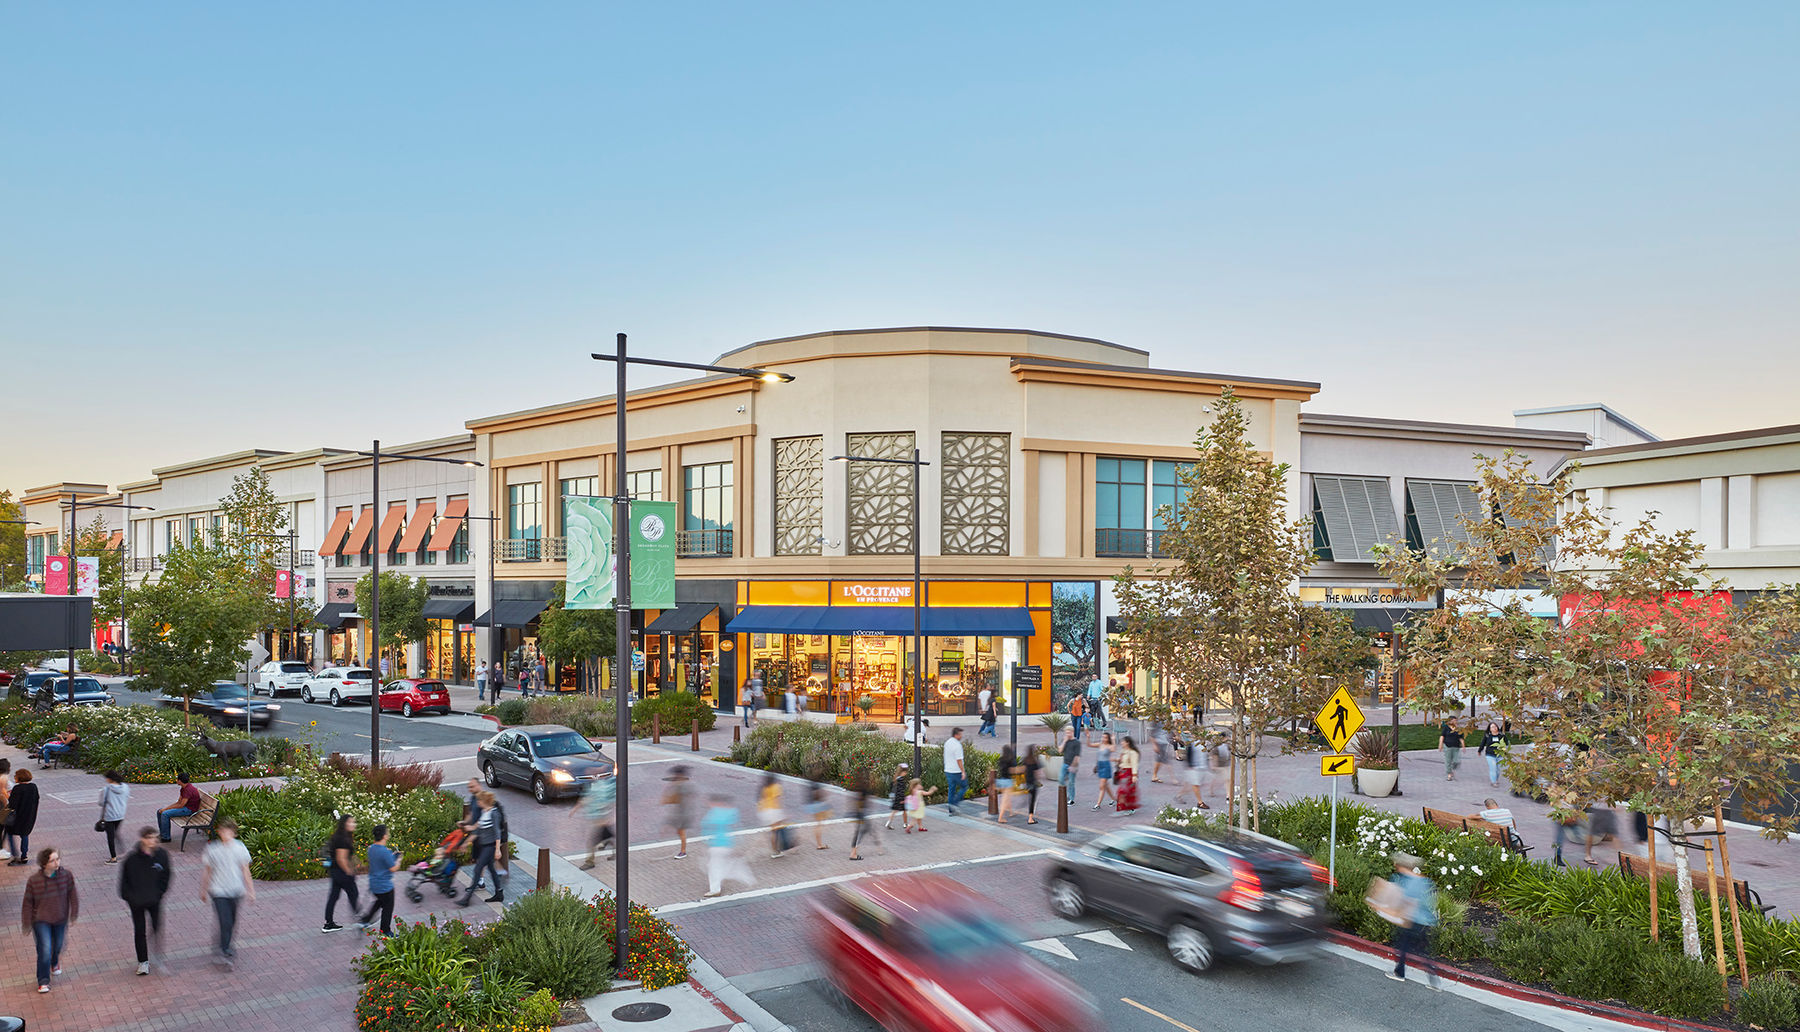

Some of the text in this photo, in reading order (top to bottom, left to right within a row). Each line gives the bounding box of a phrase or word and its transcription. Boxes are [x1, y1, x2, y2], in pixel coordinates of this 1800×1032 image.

[843, 584, 911, 597] L'OCCITANE
[1325, 594, 1340, 603] THE
[1341, 594, 1378, 603] WALKING
